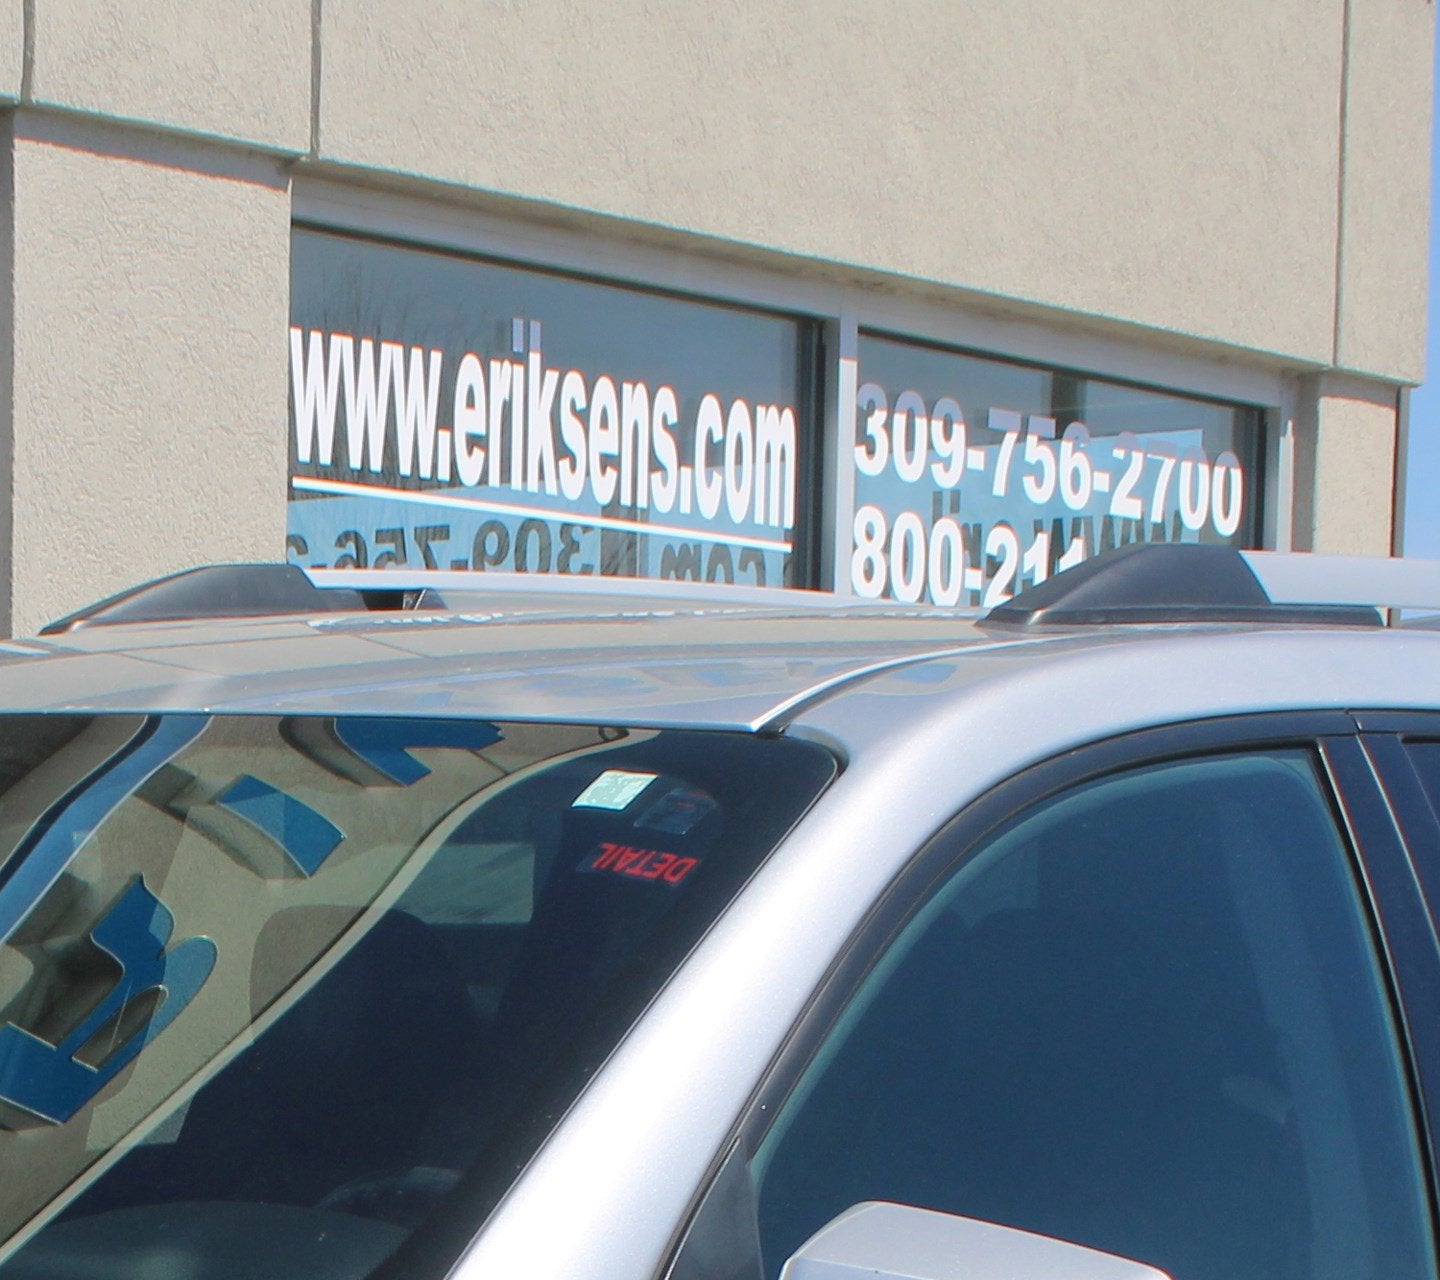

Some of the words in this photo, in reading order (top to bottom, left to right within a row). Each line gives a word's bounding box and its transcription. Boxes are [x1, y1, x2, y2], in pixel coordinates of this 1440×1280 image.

[290, 318, 795, 527] www.eriksens.com
[854, 382, 1244, 537] 309-756-2700
[591, 842, 700, 885] DETAIL
